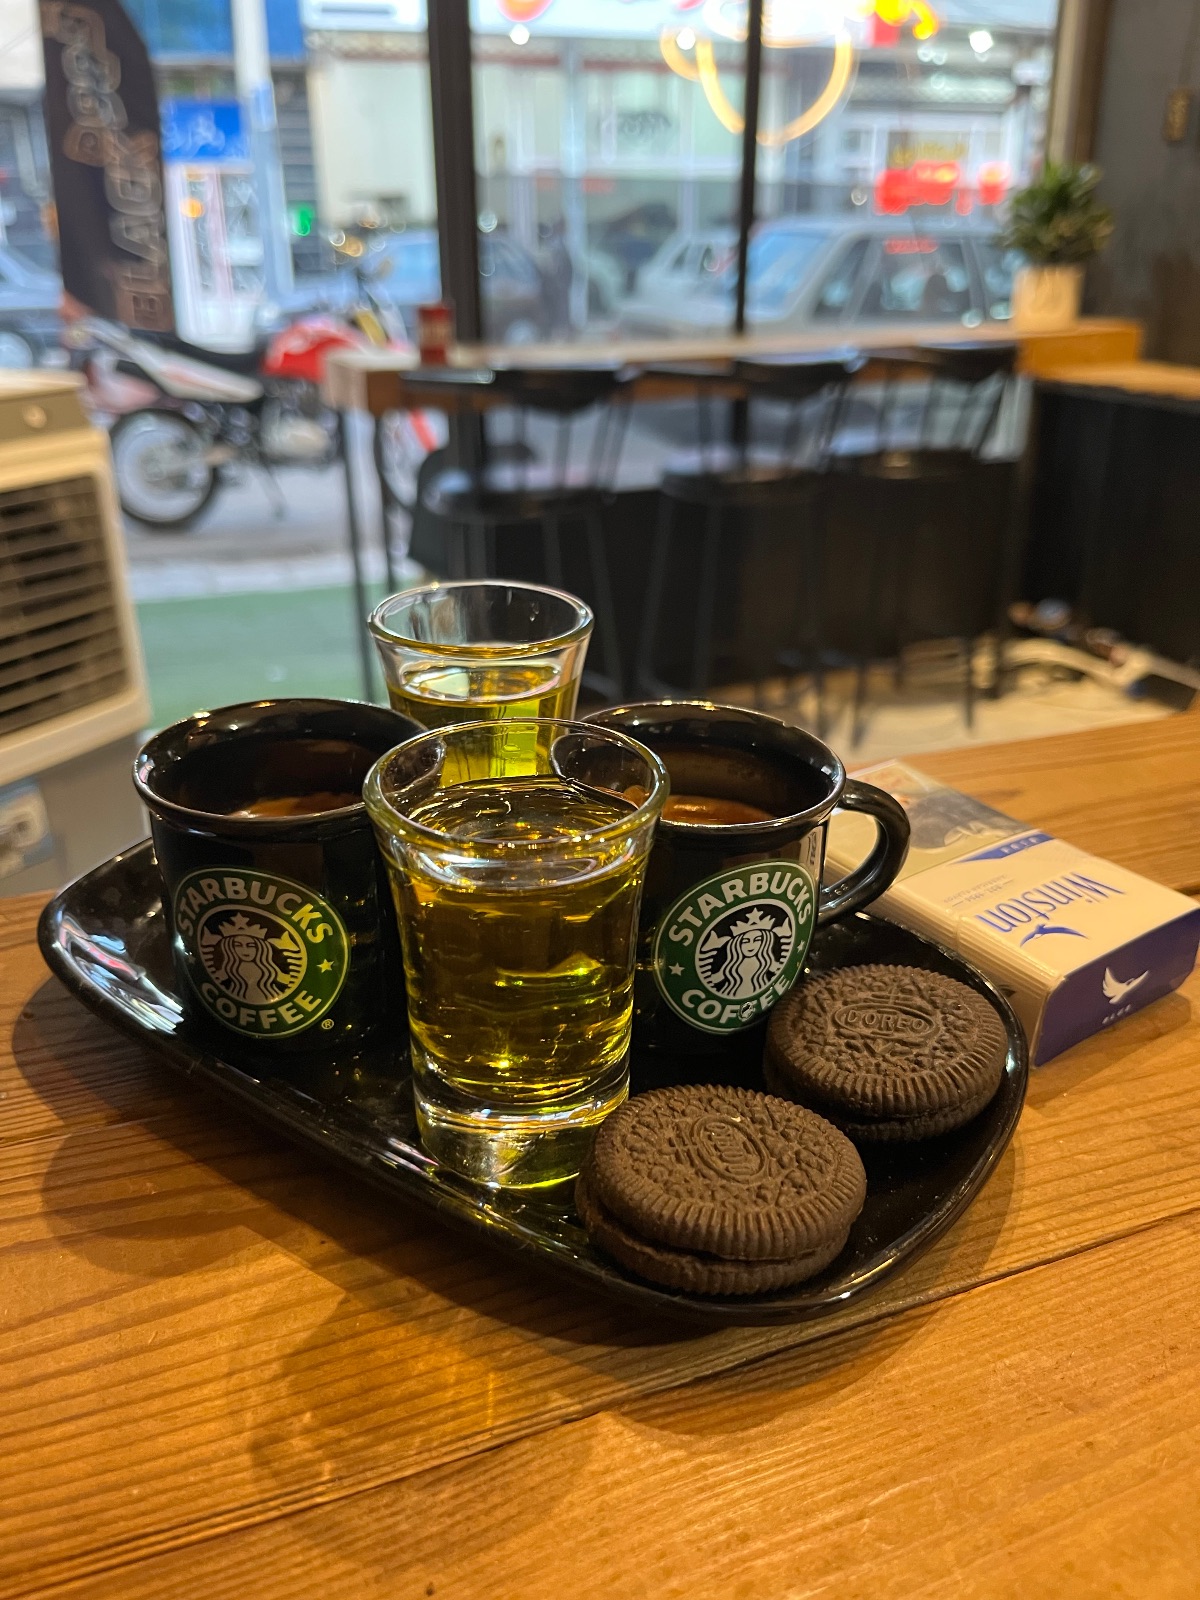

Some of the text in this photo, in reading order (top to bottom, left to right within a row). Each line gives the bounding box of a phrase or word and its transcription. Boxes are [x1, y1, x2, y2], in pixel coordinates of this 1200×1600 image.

[178, 877, 333, 943] STARBUCKS
[668, 871, 812, 946] STARBUCKS
[974, 871, 1127, 932] Winston
[201, 982, 322, 1029] COFFEE
